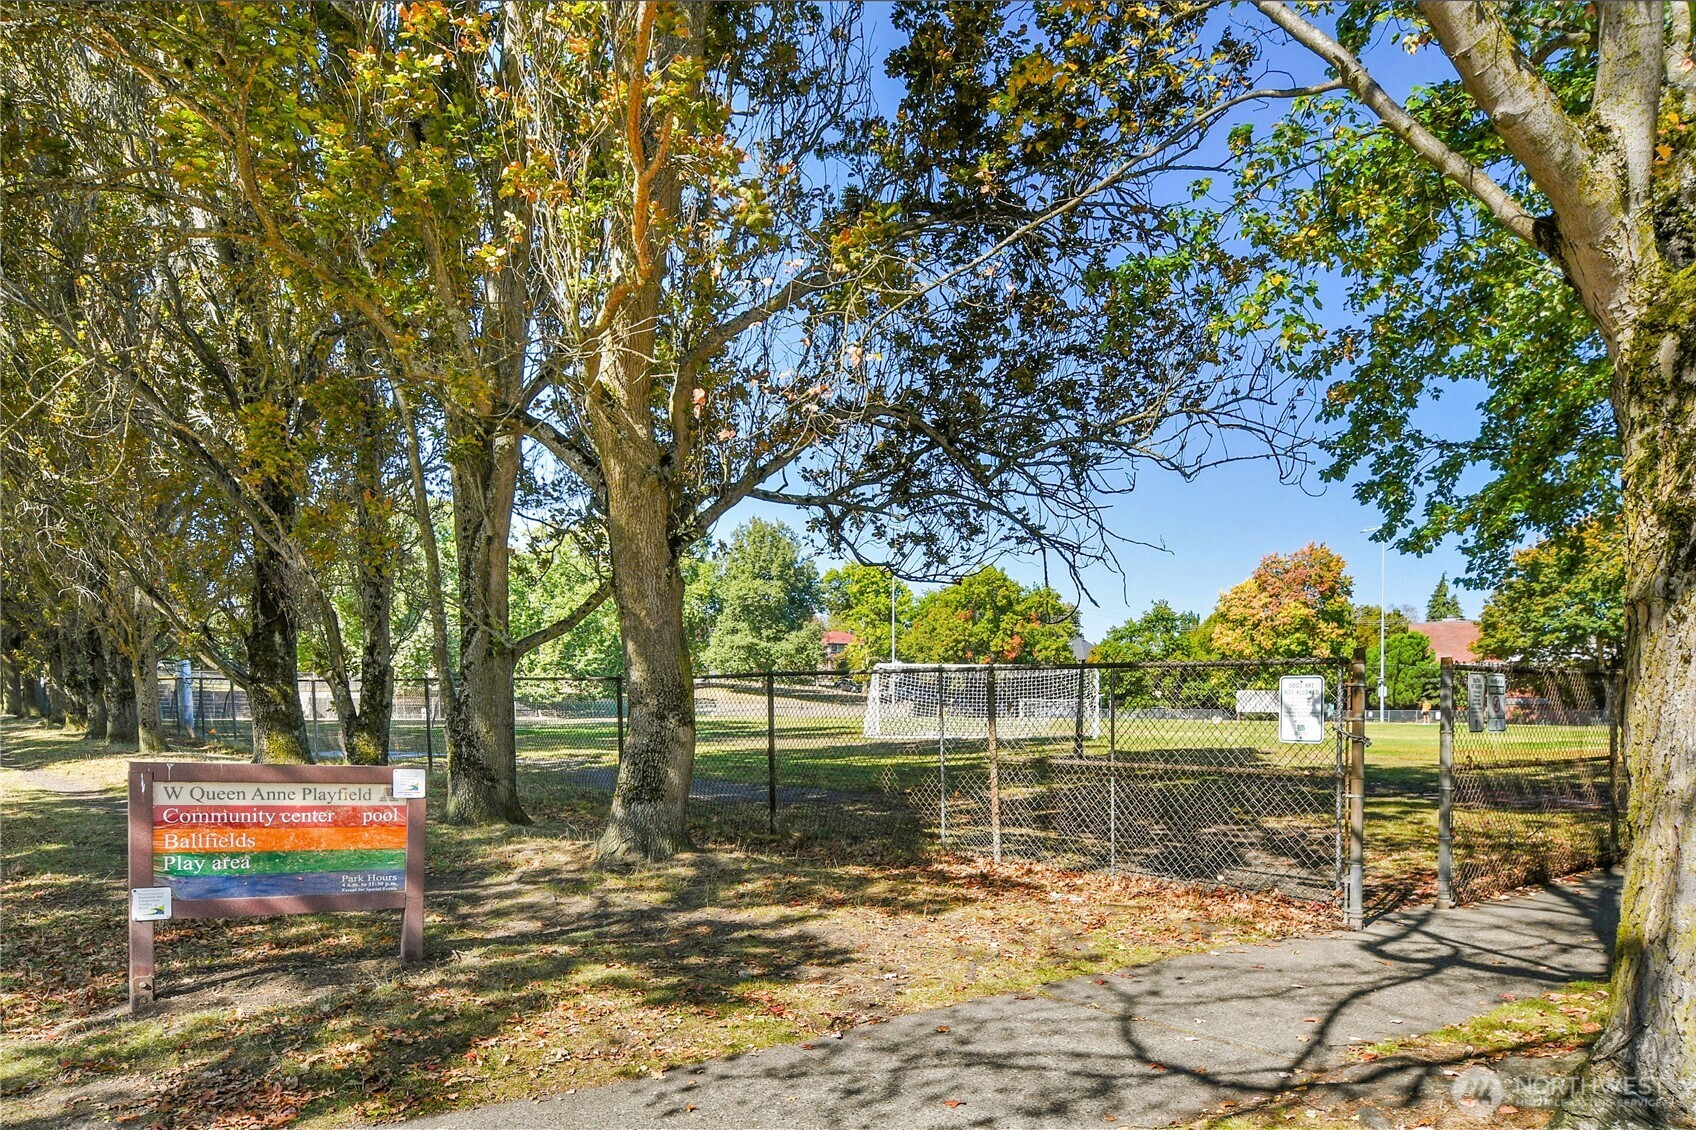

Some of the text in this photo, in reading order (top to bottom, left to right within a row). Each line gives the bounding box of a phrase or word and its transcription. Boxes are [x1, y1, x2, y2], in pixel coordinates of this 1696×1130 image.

[163, 786, 372, 804] W Queen Anne Playfield
[162, 807, 399, 827] Community center pool
[164, 832, 256, 849] Ballfields
[163, 855, 251, 874] Play area
[341, 874, 398, 882] Park Hours
